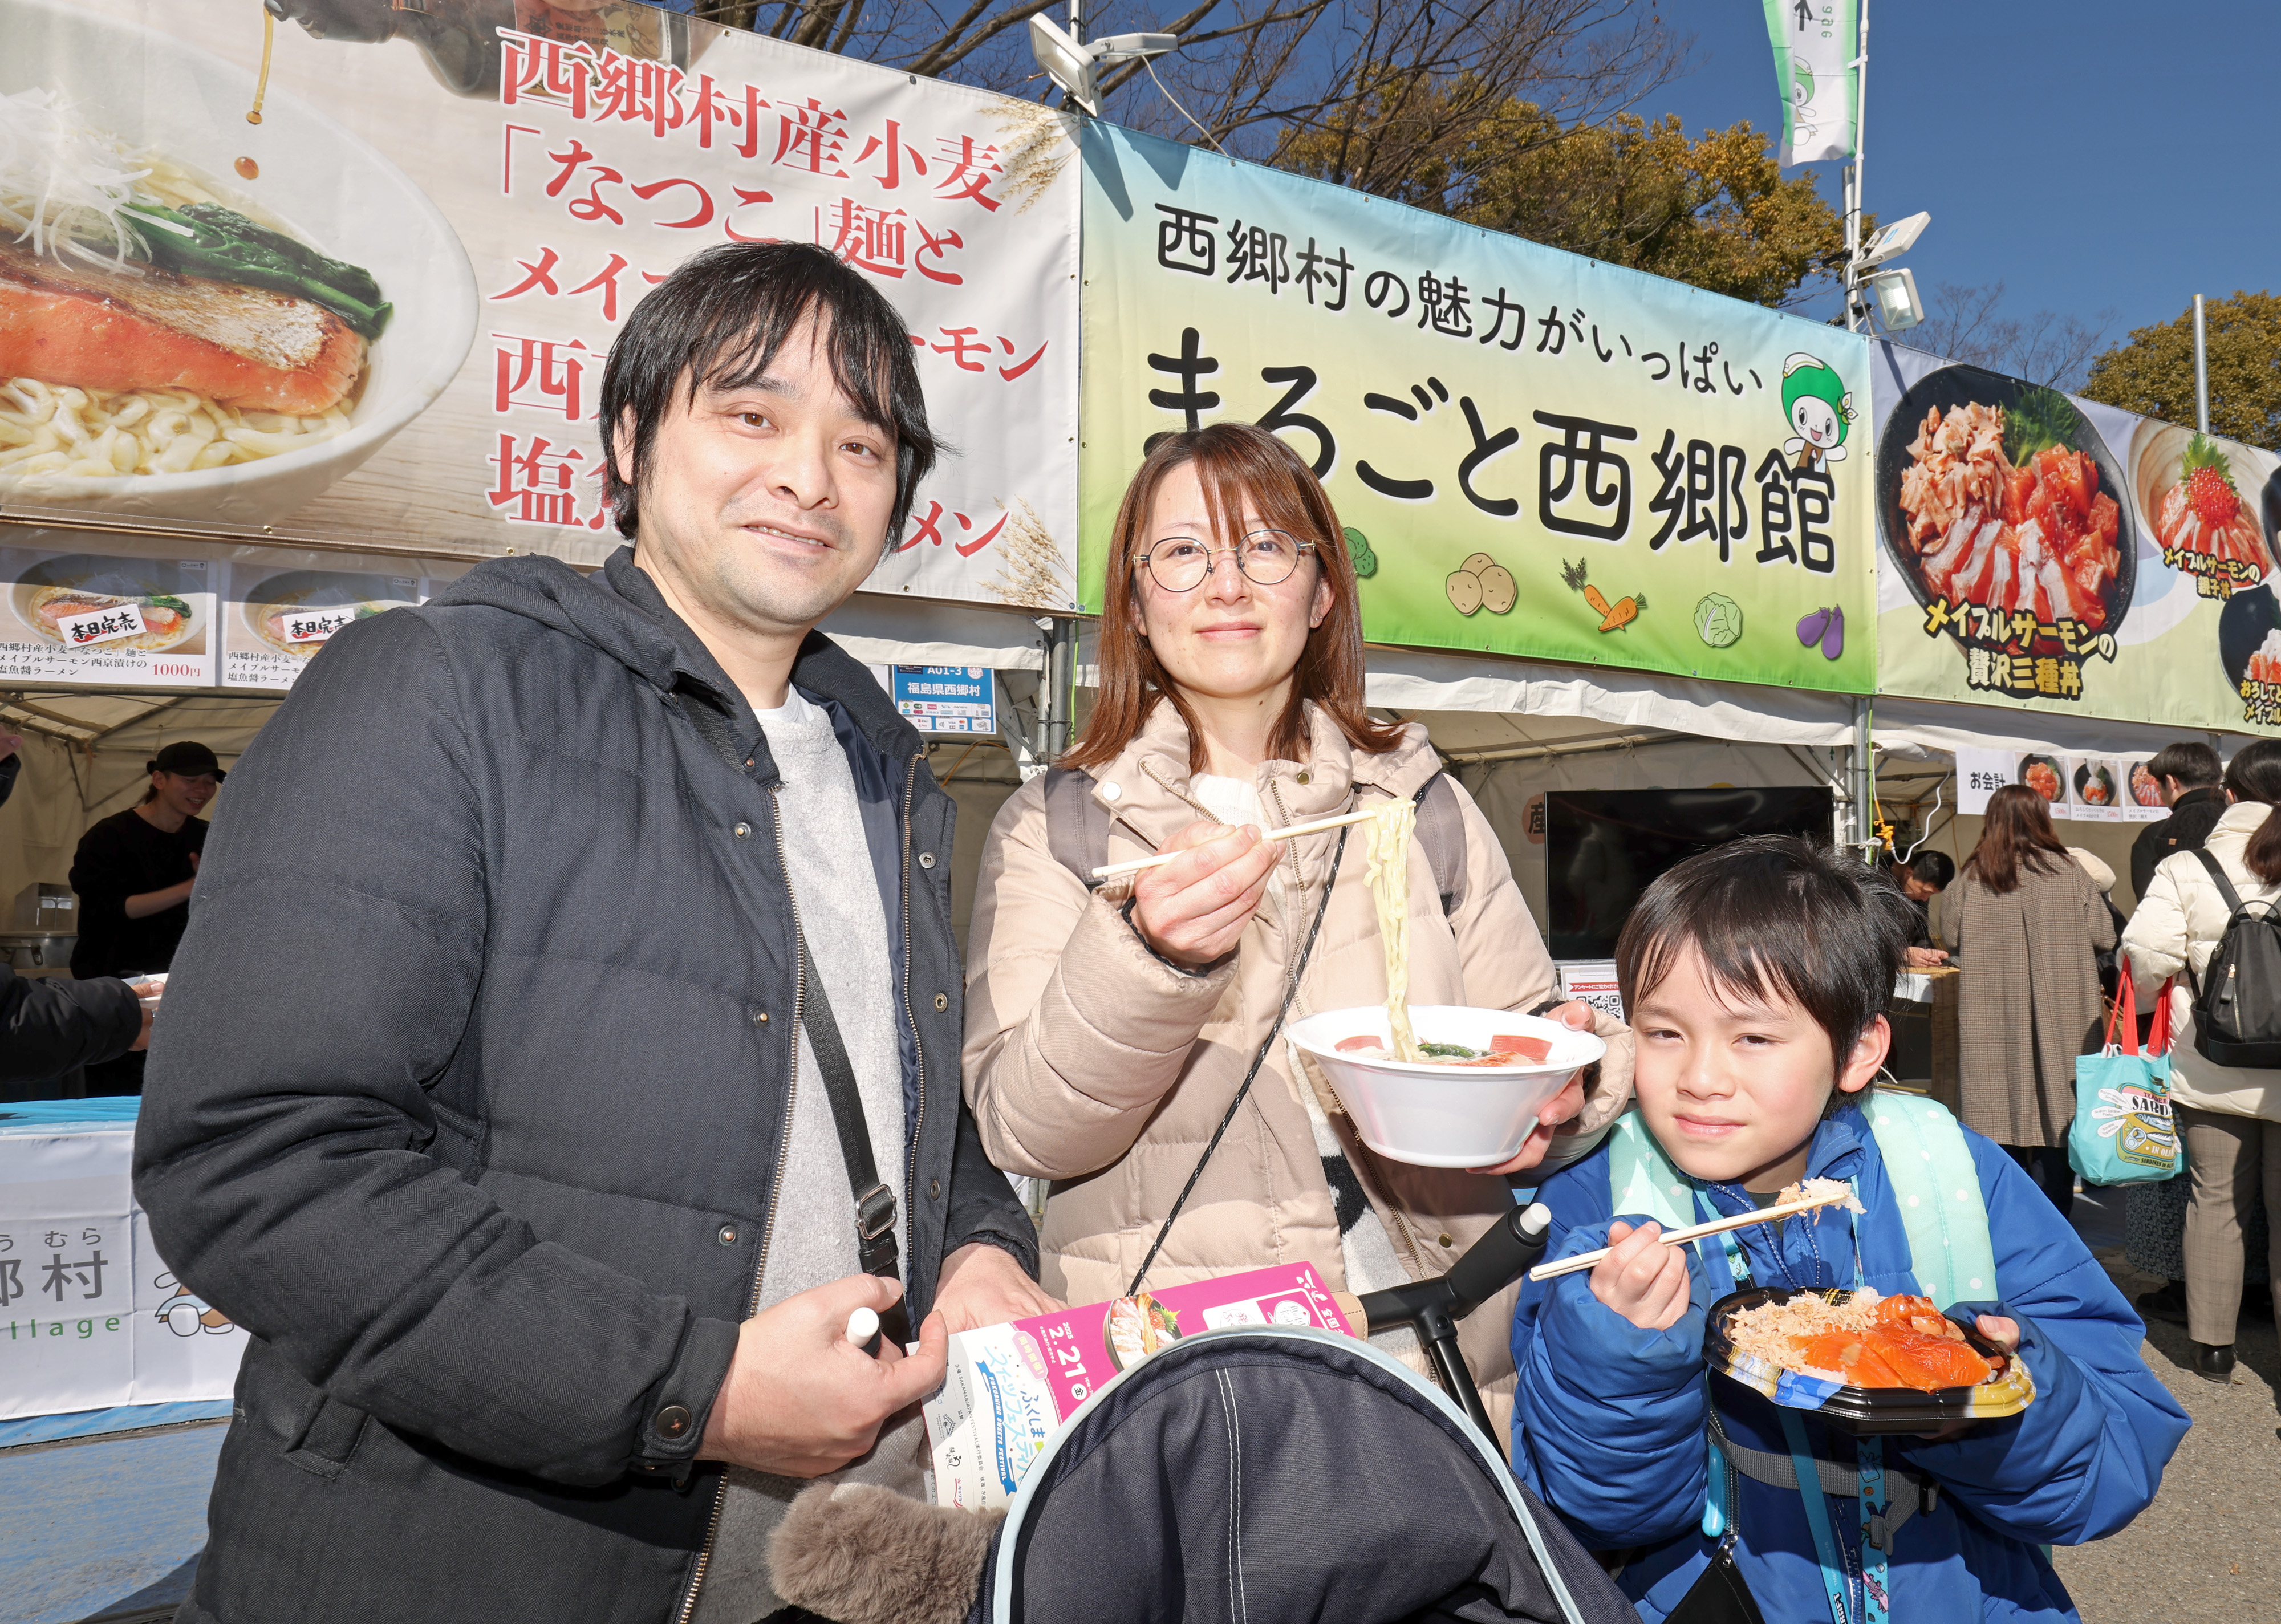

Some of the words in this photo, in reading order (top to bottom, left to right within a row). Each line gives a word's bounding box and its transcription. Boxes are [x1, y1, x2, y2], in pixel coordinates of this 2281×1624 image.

[498, 30, 1004, 212] 西郷村産小麦
[1154, 202, 1762, 395] 西郷村の魅力がいっぱい
[1144, 327, 1835, 573] まるごと西郷館
[2164, 549, 2260, 583] メイプルサーモンの
[2197, 574, 2231, 598] 親子丼
[70, 612, 139, 642] 本日完売
[1925, 599, 2116, 658] メイプルサーモンの
[153, 663, 200, 677] 1000円
[228, 673, 294, 684] 塩魚醤ラーメ
[1969, 649, 2081, 696] 贅沢三種丼
[907, 682, 981, 697] 福島県西郷村
[1970, 771, 2006, 790] お会計
[1062, 1322, 1074, 1339] 2025
[988, 1376, 1001, 1415] FUKUSHIMA
[1074, 1386, 1085, 1397] 金
[957, 1410, 964, 1420] 協賛
[1020, 1390, 1046, 1439] ふくしま
[996, 1417, 1004, 1445] SWEETS
[998, 1447, 1007, 1481] FESTIVAL
